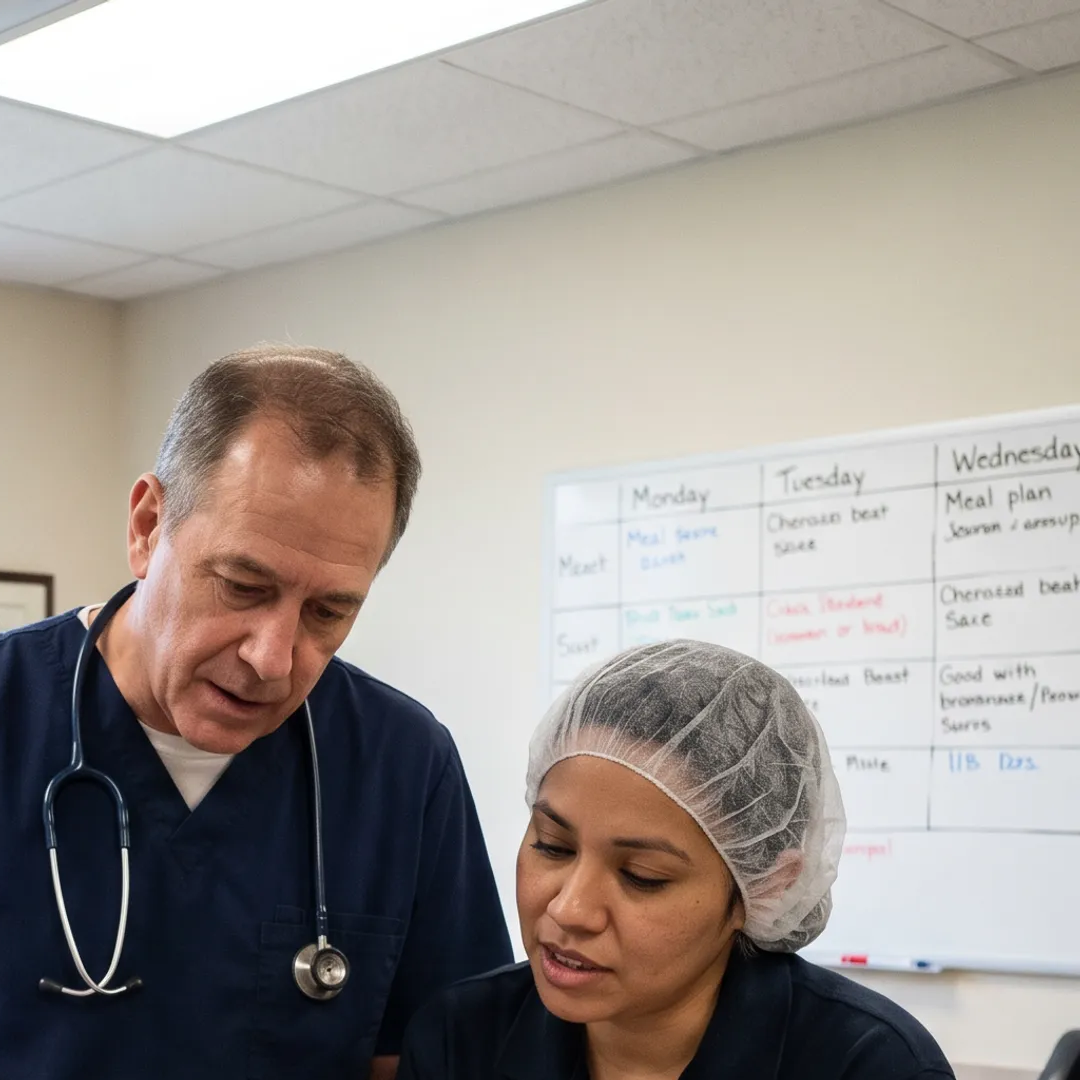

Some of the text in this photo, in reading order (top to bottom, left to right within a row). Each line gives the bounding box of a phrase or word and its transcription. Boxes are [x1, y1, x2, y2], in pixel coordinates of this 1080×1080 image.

[952, 435, 1080, 474] Wednesday
[776, 463, 865, 496] Tuesday
[633, 485, 710, 513] Monday
[945, 482, 1052, 514] Meal plan
[940, 661, 1036, 686] Good with
